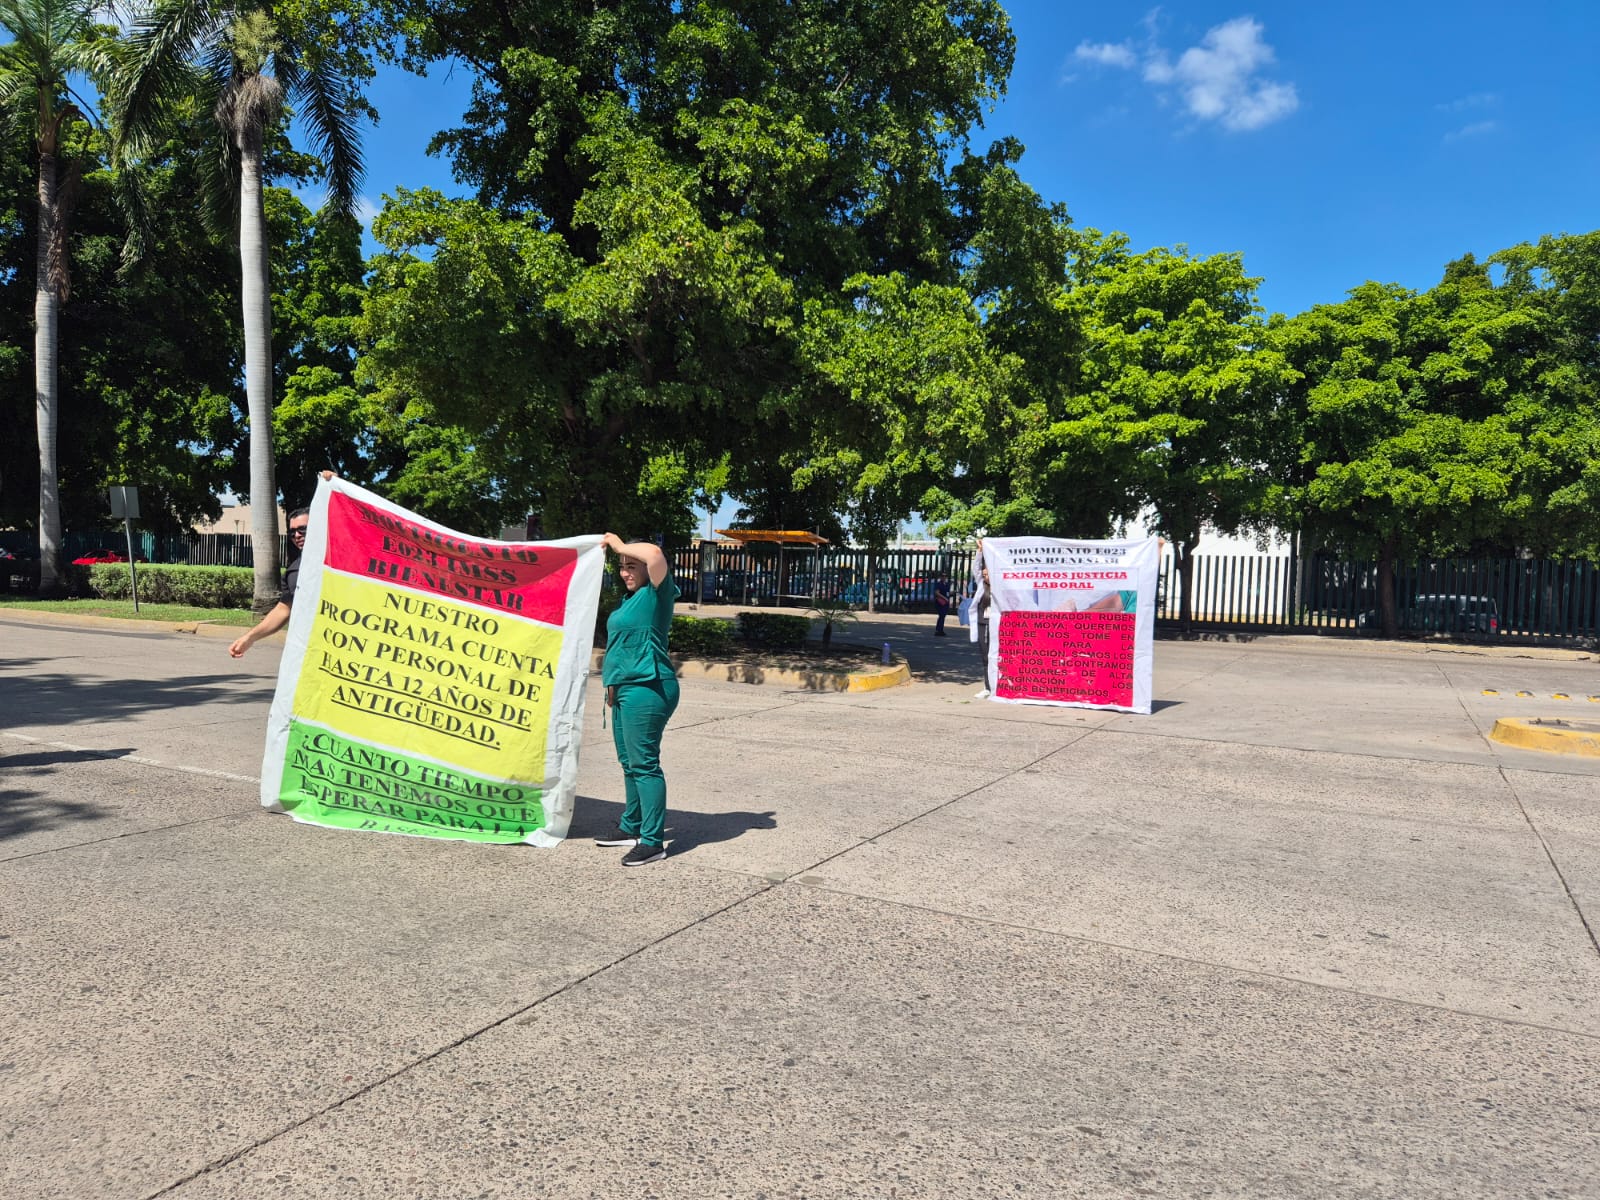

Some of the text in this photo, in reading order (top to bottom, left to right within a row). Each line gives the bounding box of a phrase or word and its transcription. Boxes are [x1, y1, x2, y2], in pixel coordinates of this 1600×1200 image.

[1008, 547, 1091, 556] MOVIMIENTO
[448, 558, 516, 583] IMSS
[1003, 571, 1128, 580] EXIGIMOS JUSTICIA
[368, 559, 525, 610] BIENESTAR
[1033, 581, 1094, 590] LABORAL
[384, 592, 499, 636] NUESTRO
[1074, 623, 1135, 631] QUEREMOS
[320, 600, 555, 679] PROGRAMA CUENTA
[999, 639, 1032, 647] CUENTA
[1063, 641, 1092, 649] PARA
[1047, 631, 1070, 639] NOS
[1081, 632, 1111, 640] TOME
[1121, 633, 1135, 641] EN
[324, 628, 541, 703] CON PERSONAL DE
[1051, 659, 1133, 670] ENCONTRAMOS
[1114, 653, 1134, 661] LOS
[1018, 667, 1068, 676] LUGARES
[1081, 670, 1096, 678] DE
[1109, 671, 1133, 680] ALTA
[322, 651, 532, 728] HASTA 12 AÑOS DE
[1112, 682, 1133, 690] LOS
[332, 685, 501, 745] ANTIGÜEDAD.
[302, 733, 524, 801] ¿CUANTO TIEMPO
[294, 750, 537, 822] MAS TENEMOS QUE
[416, 810, 484, 832] PARA
